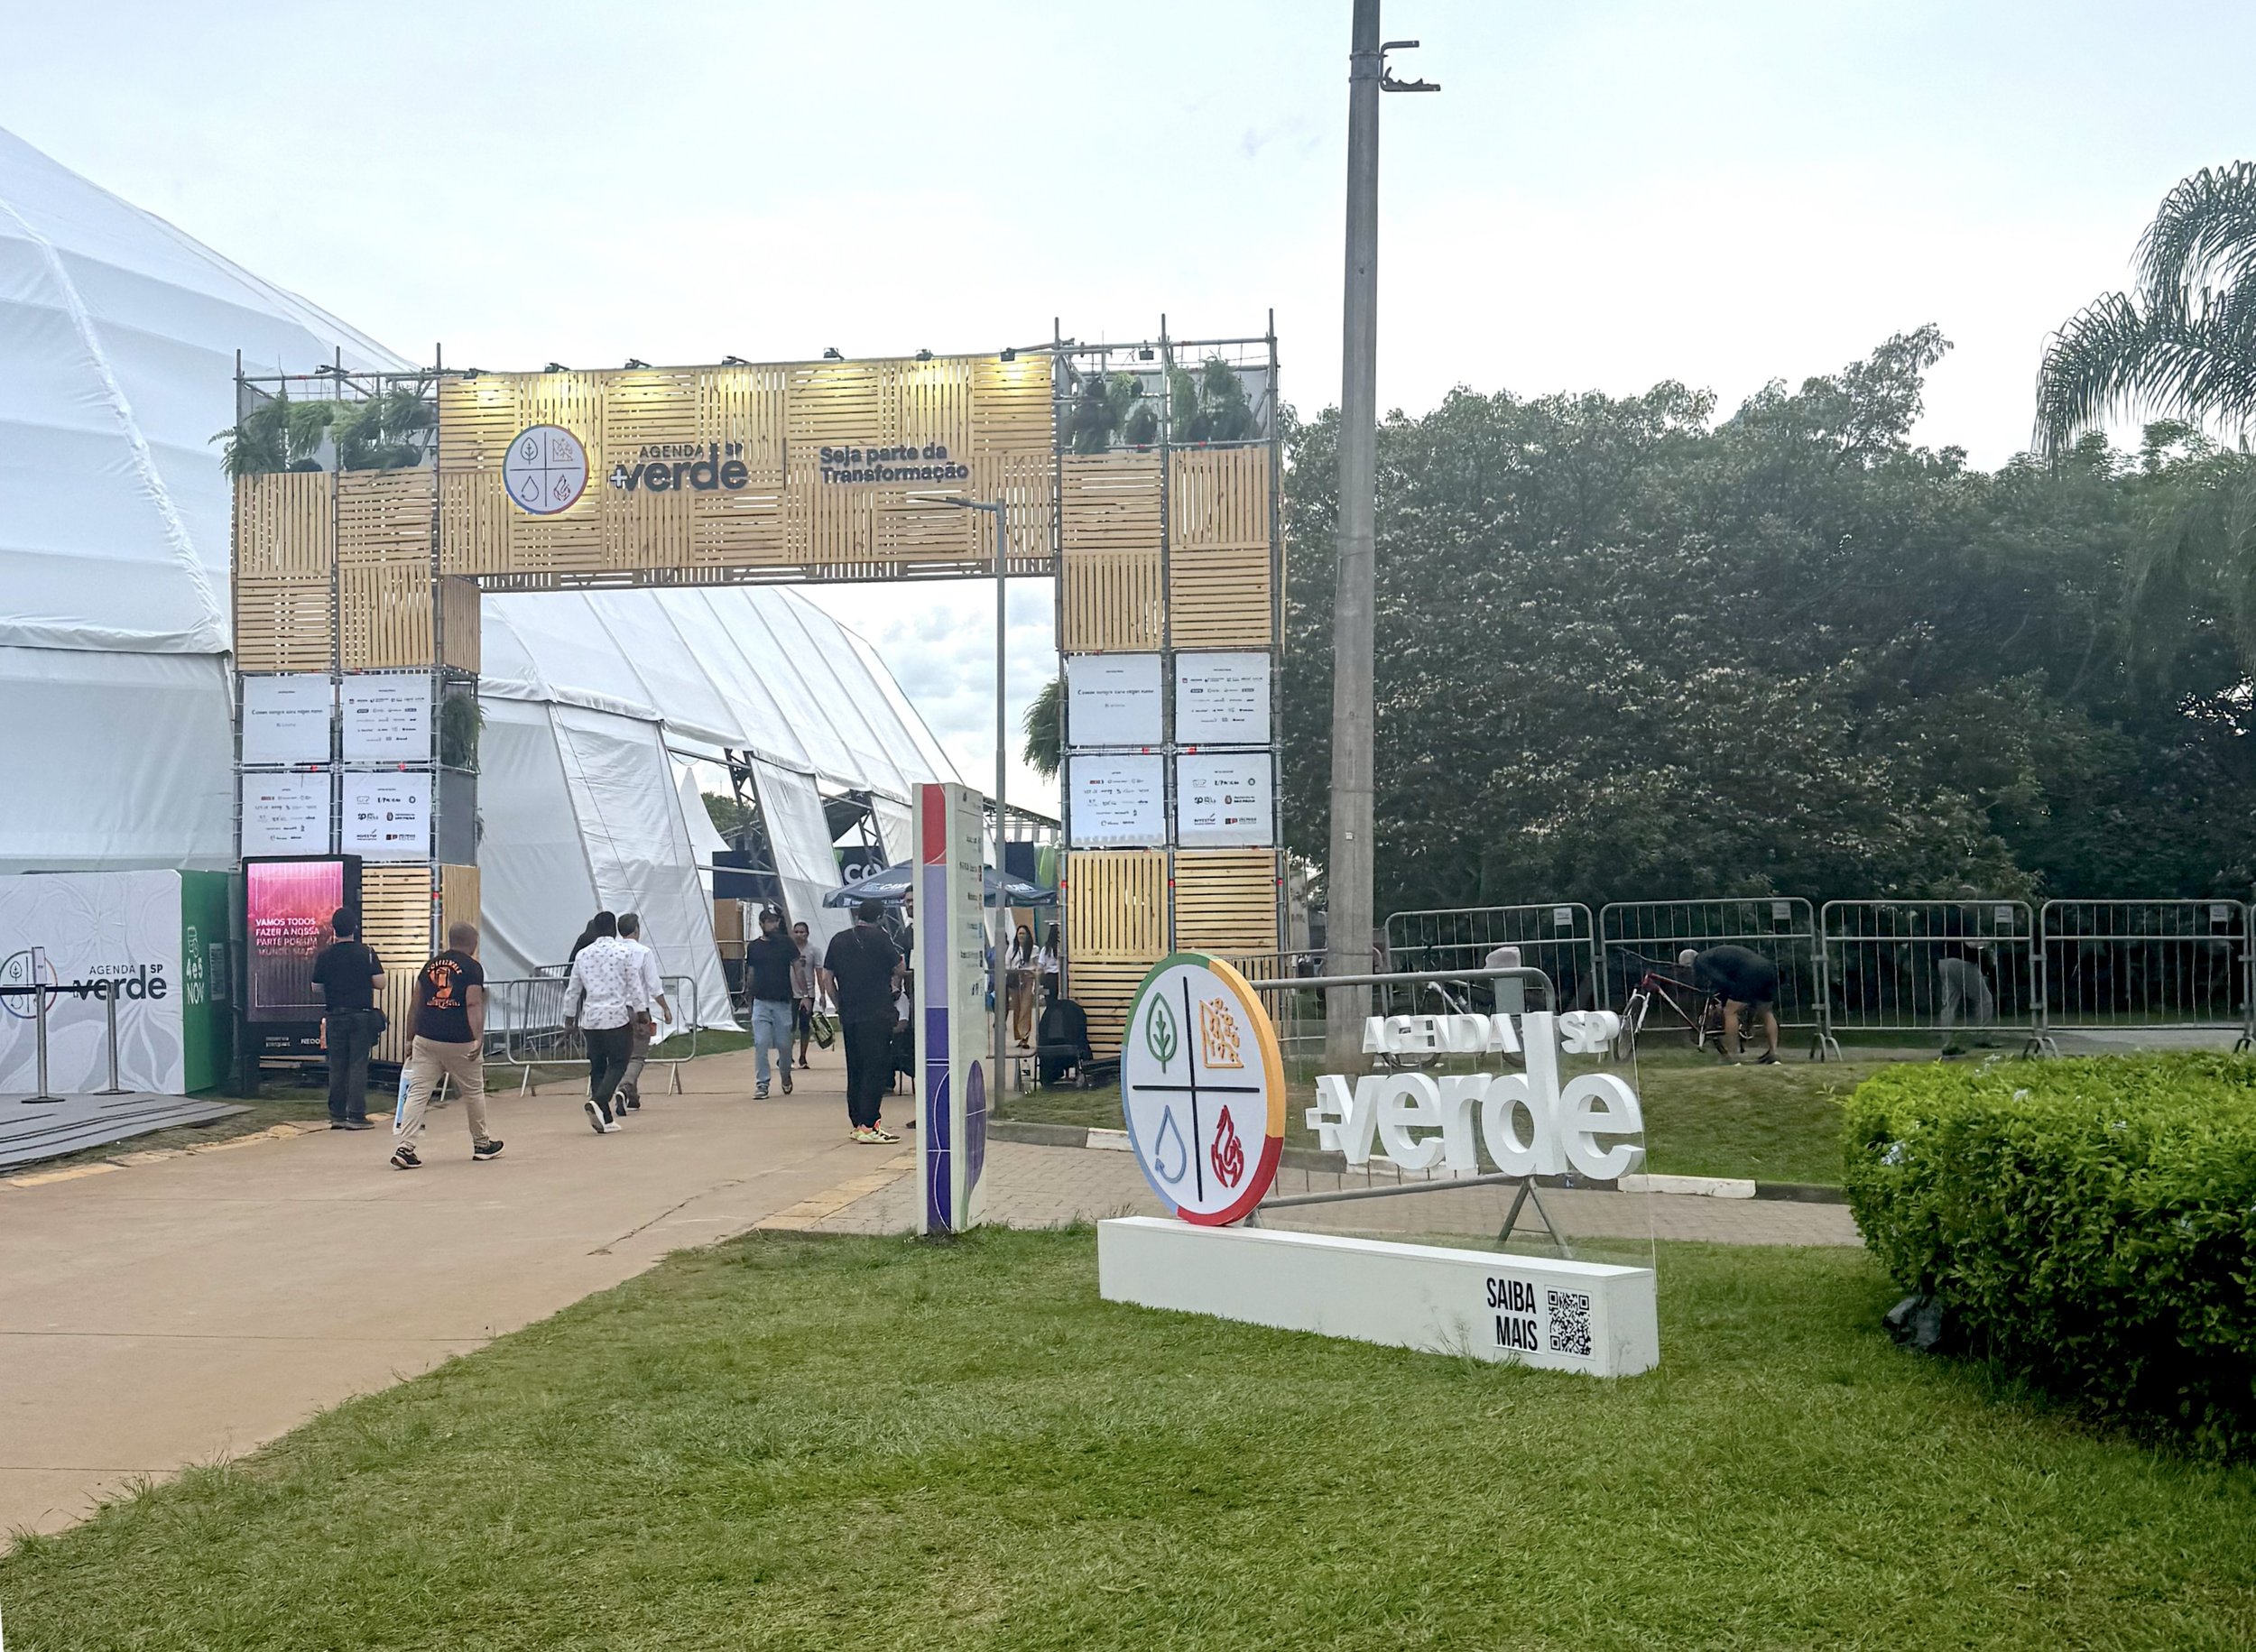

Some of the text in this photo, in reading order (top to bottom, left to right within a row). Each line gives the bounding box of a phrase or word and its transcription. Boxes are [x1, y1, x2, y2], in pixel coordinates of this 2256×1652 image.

[640, 445, 704, 458] AGENDA
[819, 441, 948, 466] Seja parte da
[819, 461, 969, 484] Transformação
[255, 917, 316, 927] VAMOS TODOS
[255, 927, 319, 937] FAZER A NOSSA
[256, 937, 282, 946] PARTE
[89, 964, 163, 975] AGENDA SP
[186, 982, 205, 1006] NOV
[1362, 1010, 1620, 1055] AGENDA SP
[1486, 1277, 1537, 1315] SAIBA
[1495, 1315, 1538, 1352] MAIS
